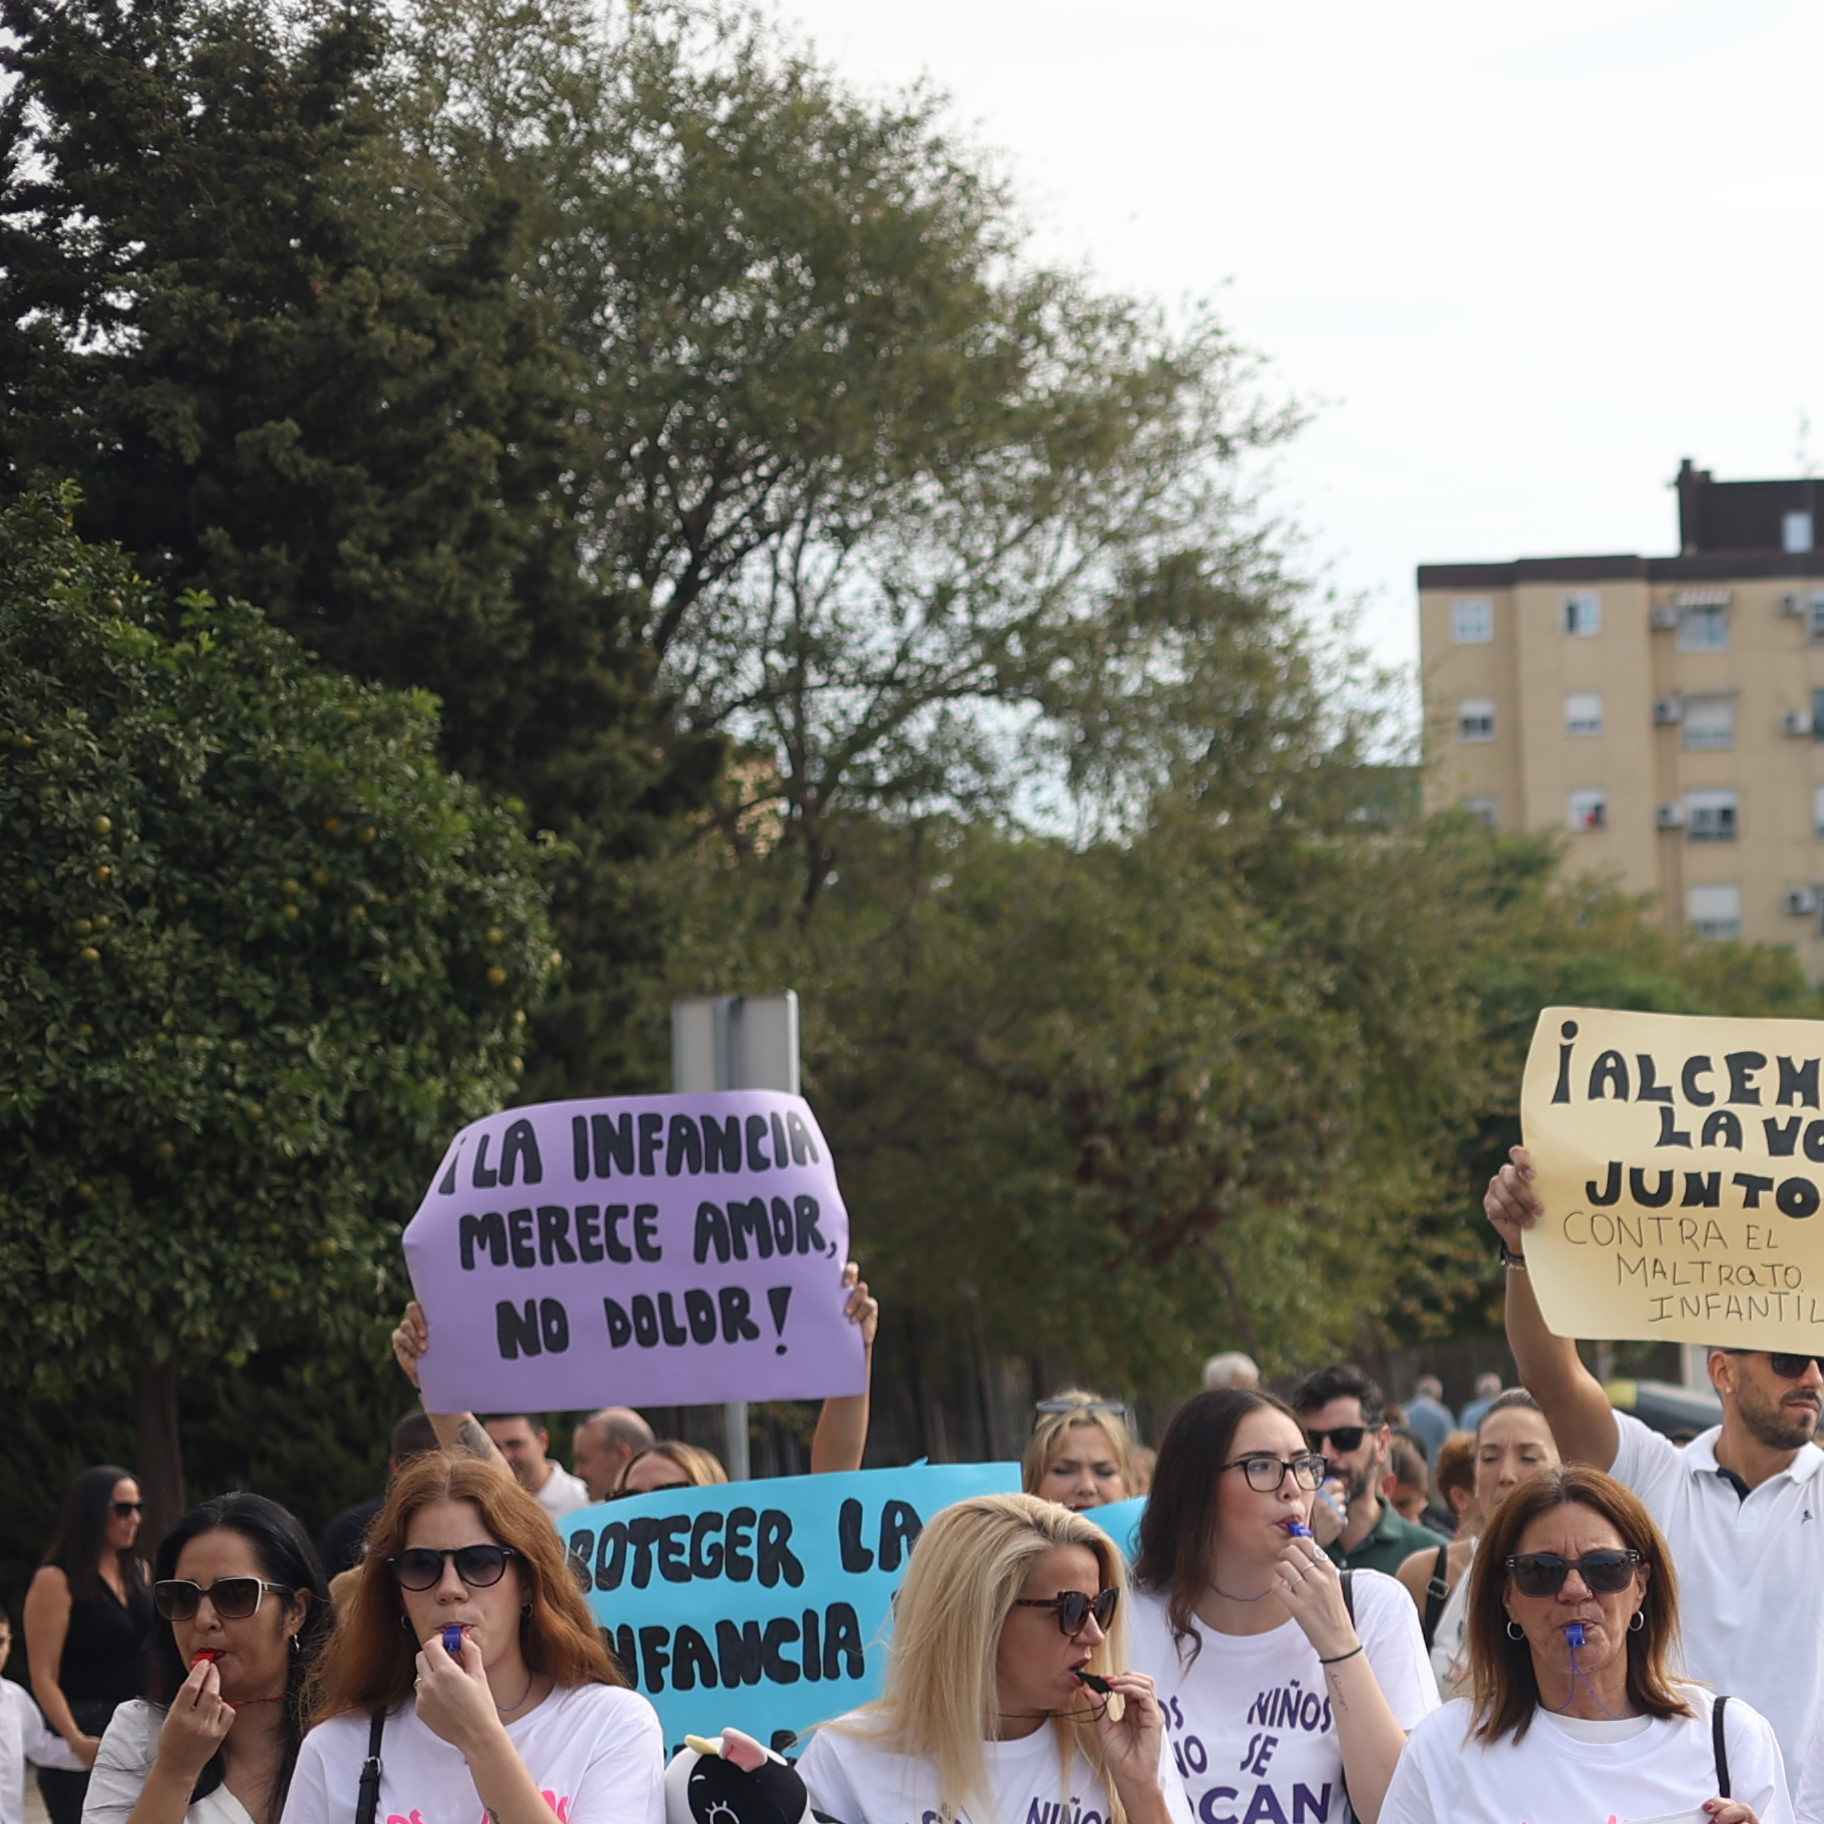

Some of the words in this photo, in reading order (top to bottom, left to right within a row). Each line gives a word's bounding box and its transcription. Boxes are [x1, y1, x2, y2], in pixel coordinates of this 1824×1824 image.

[573, 1108, 819, 1180] INFANCIA
[1655, 1106, 1744, 1151] LA
[459, 1204, 662, 1271] MERECE
[693, 1194, 838, 1264] AMOR,
[1563, 1210, 1729, 1251] CONTRA
[1745, 1224, 1779, 1250] EL
[496, 1298, 569, 1360] NO
[606, 1284, 794, 1356] DOLOR!
[567, 1506, 805, 1595] ROTEGER
[838, 1497, 925, 1575] LA
[599, 1601, 866, 1695] NFANCIA
[1246, 1678, 1333, 1734] NIÑOS
[1239, 1731, 1280, 1778] SE
